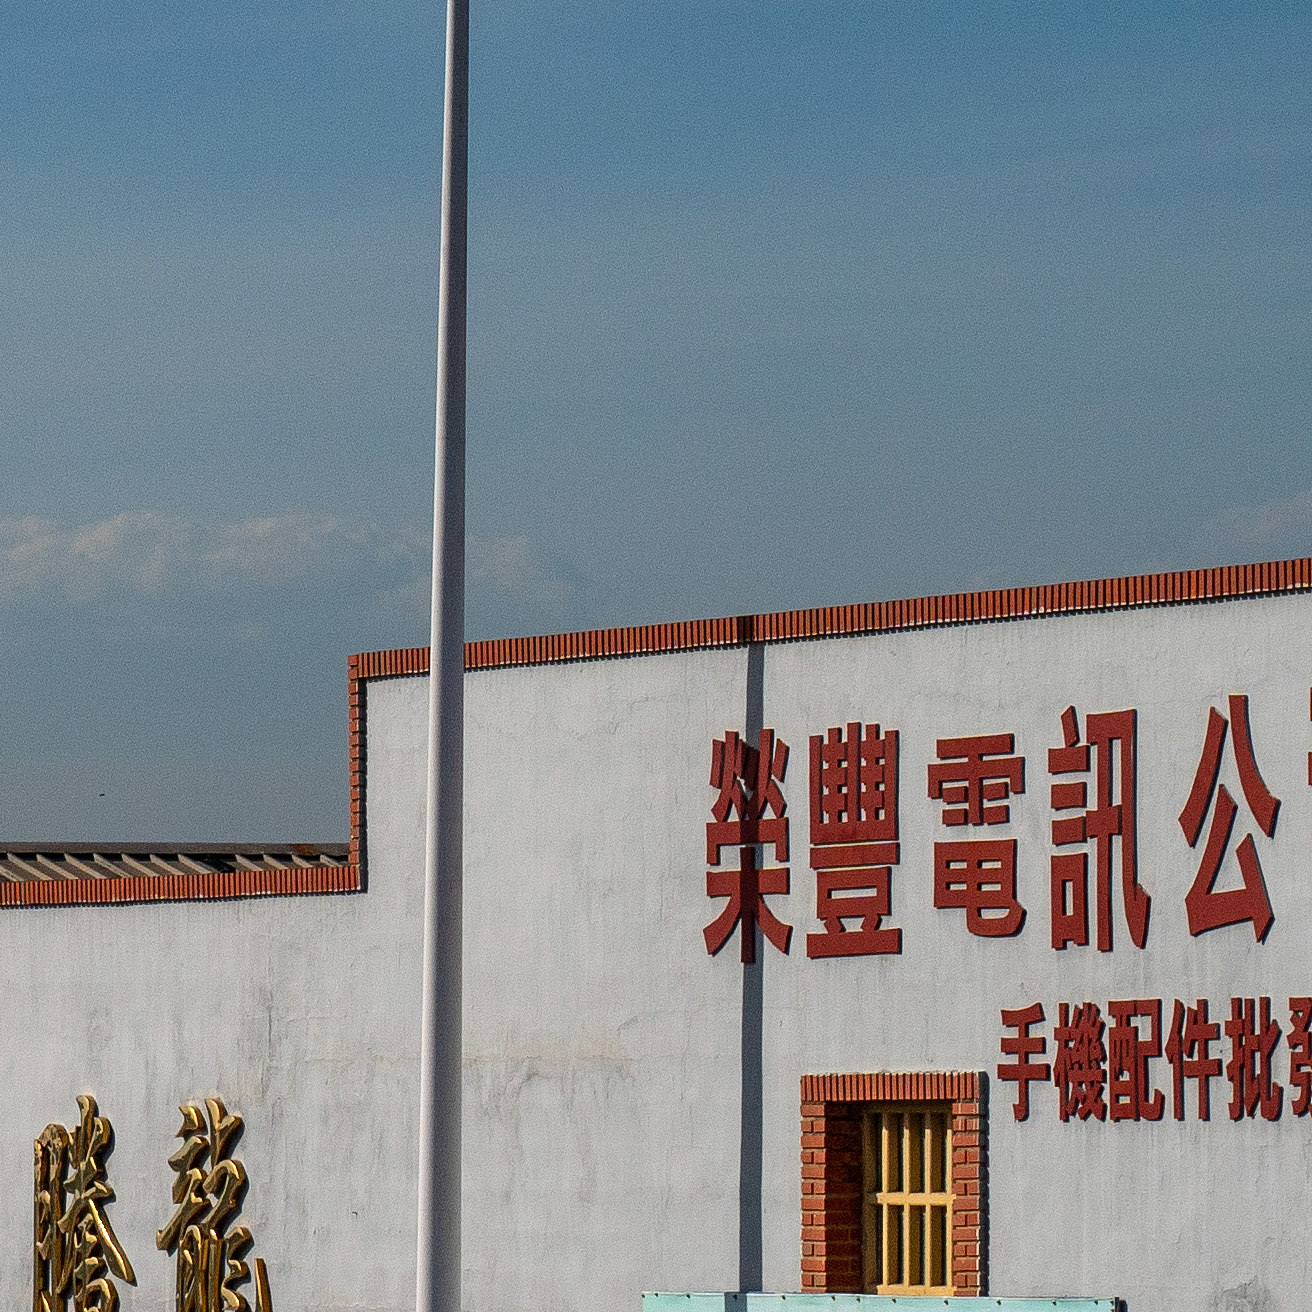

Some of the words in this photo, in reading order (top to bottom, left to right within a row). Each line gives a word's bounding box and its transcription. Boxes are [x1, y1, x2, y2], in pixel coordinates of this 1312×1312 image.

[703, 694, 1312, 964] 榮豐電訊公
